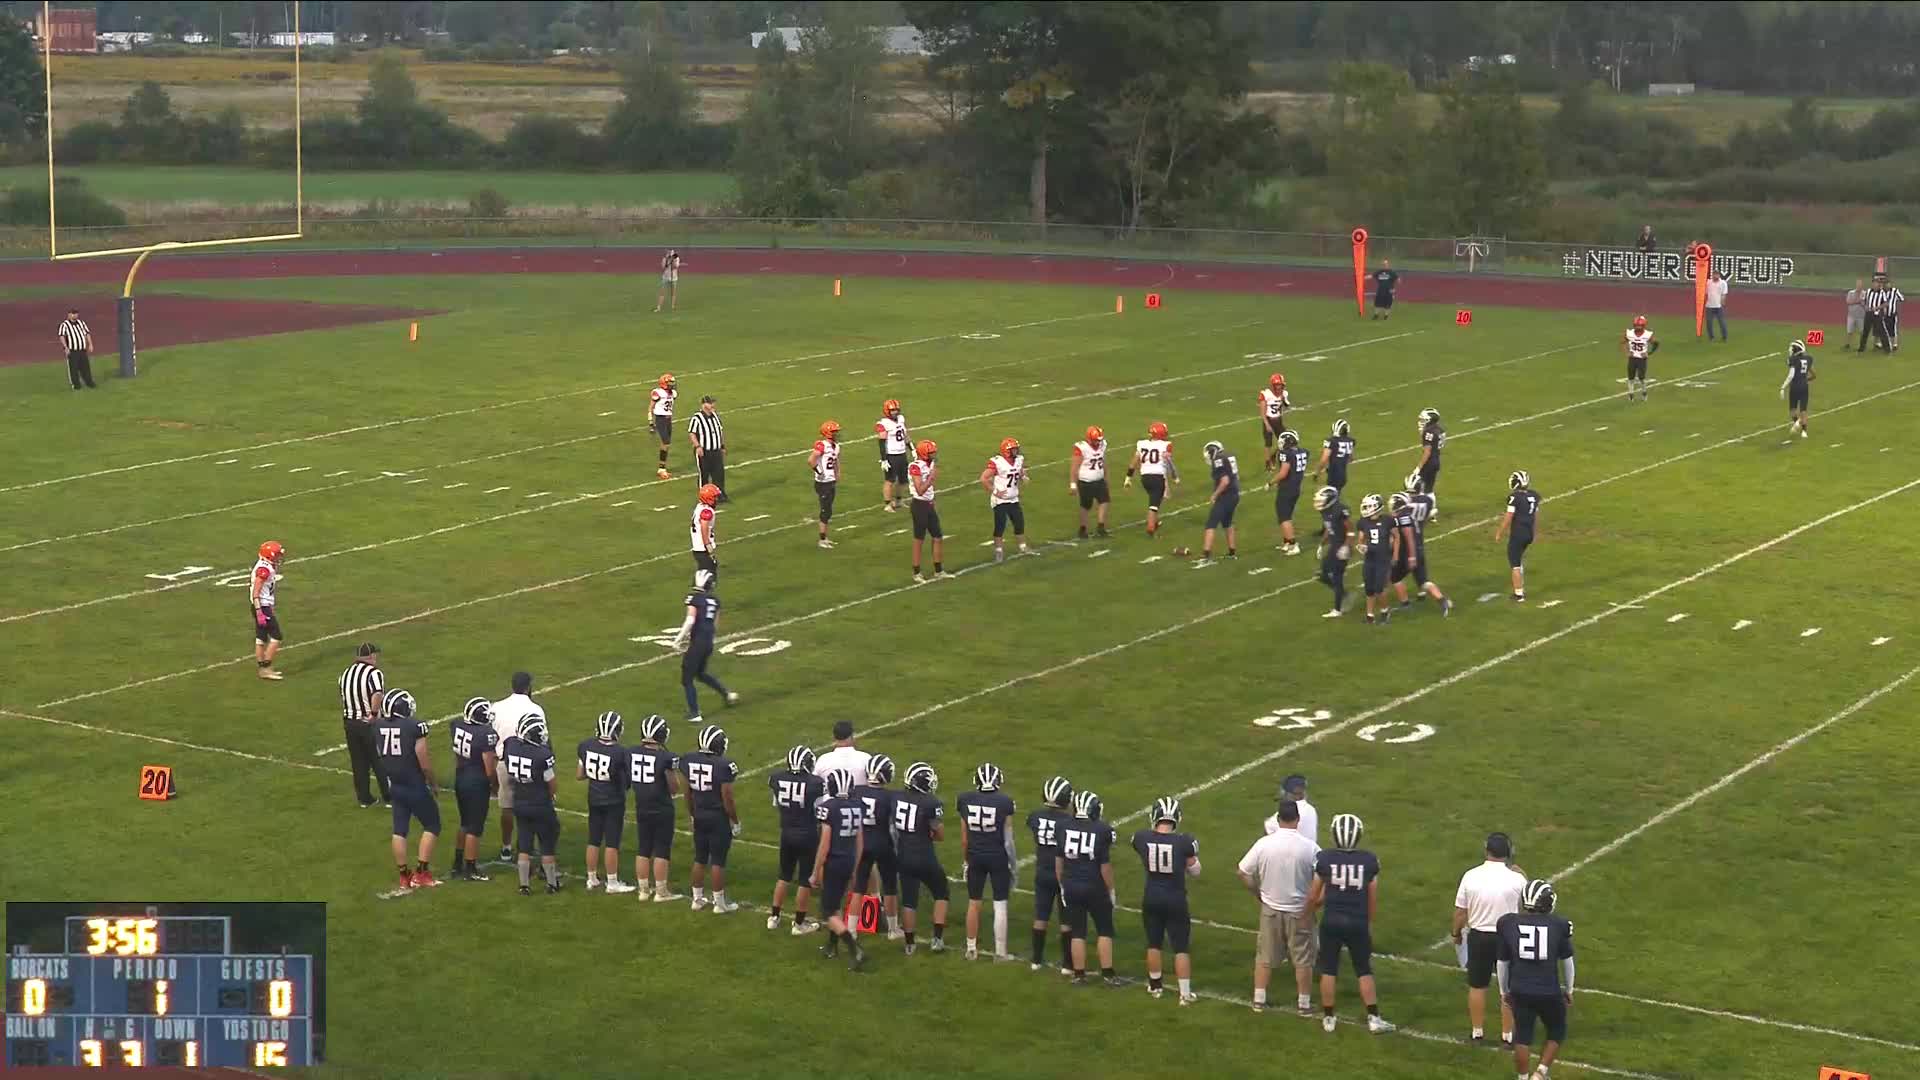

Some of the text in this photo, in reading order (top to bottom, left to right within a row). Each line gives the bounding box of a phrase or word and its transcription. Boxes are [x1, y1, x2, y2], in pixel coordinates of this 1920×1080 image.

[1457, 311, 1470, 323] 10
[1808, 332, 1821, 343] 20
[1140, 448, 1159, 464] 70
[1527, 497, 1536, 514] 7
[1370, 529, 1379, 544] 9
[379, 728, 402, 755] 76
[452, 727, 473, 758] 56
[142, 769, 166, 795] 20
[508, 755, 533, 783] 55
[631, 753, 656, 783] 62
[688, 762, 713, 791] 52
[777, 780, 806, 808] 24
[816, 806, 829, 820] 33
[840, 808, 862, 837] 33
[895, 800, 918, 832] 51
[967, 804, 996, 832] 22
[1063, 829, 1096, 860] 64
[1147, 843, 1174, 873] 10
[1330, 864, 1364, 891] 44
[1517, 925, 1549, 960] 21
